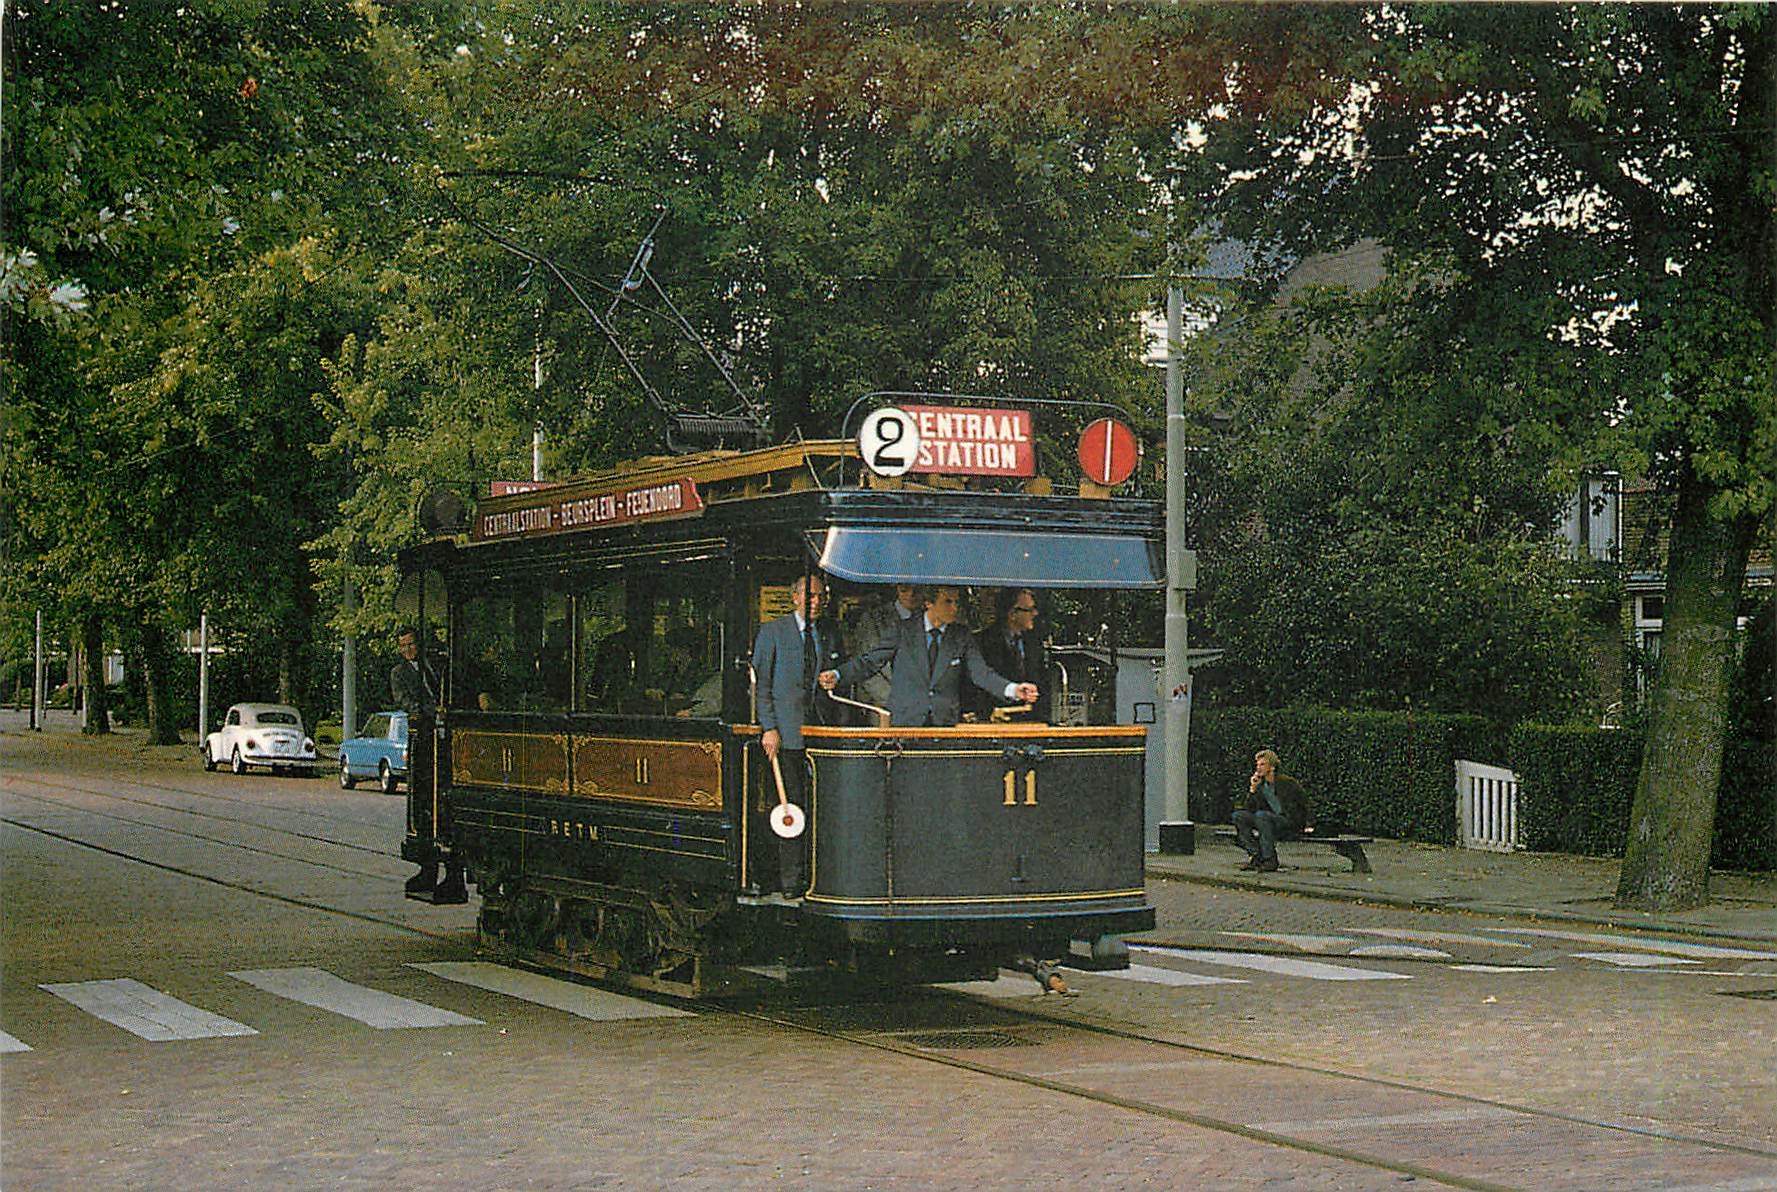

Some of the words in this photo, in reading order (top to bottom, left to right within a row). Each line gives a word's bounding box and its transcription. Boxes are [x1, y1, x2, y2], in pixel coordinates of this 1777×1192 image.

[873, 416, 905, 467] 2
[918, 441, 1017, 469] STATION
[1002, 770, 1039, 806] 11
